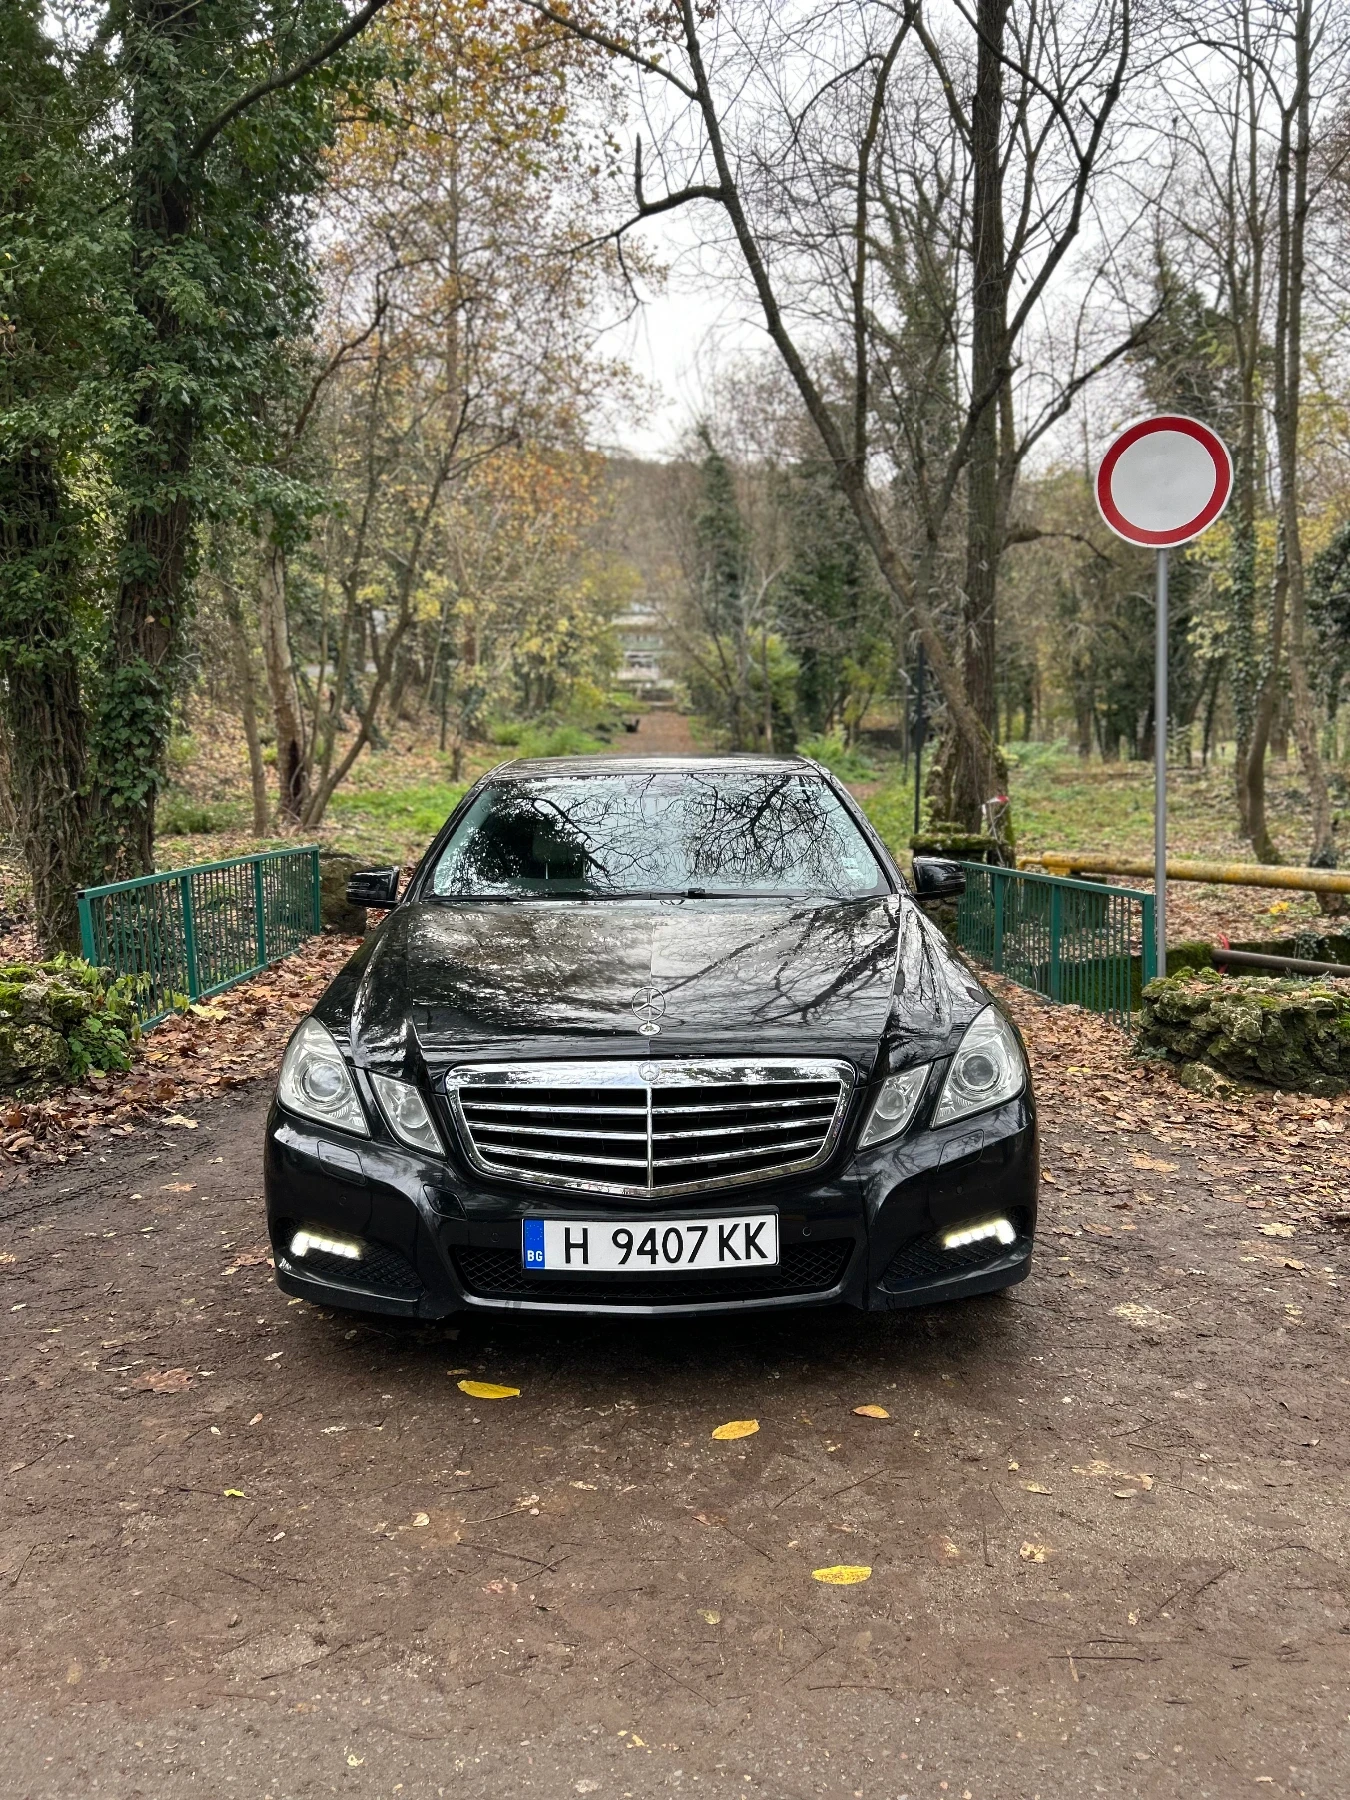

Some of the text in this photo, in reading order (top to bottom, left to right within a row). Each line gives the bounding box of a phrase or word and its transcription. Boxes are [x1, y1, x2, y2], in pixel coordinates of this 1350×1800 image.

[526, 1249, 544, 1262] BG
[564, 1221, 769, 1265] H 9407 KK
